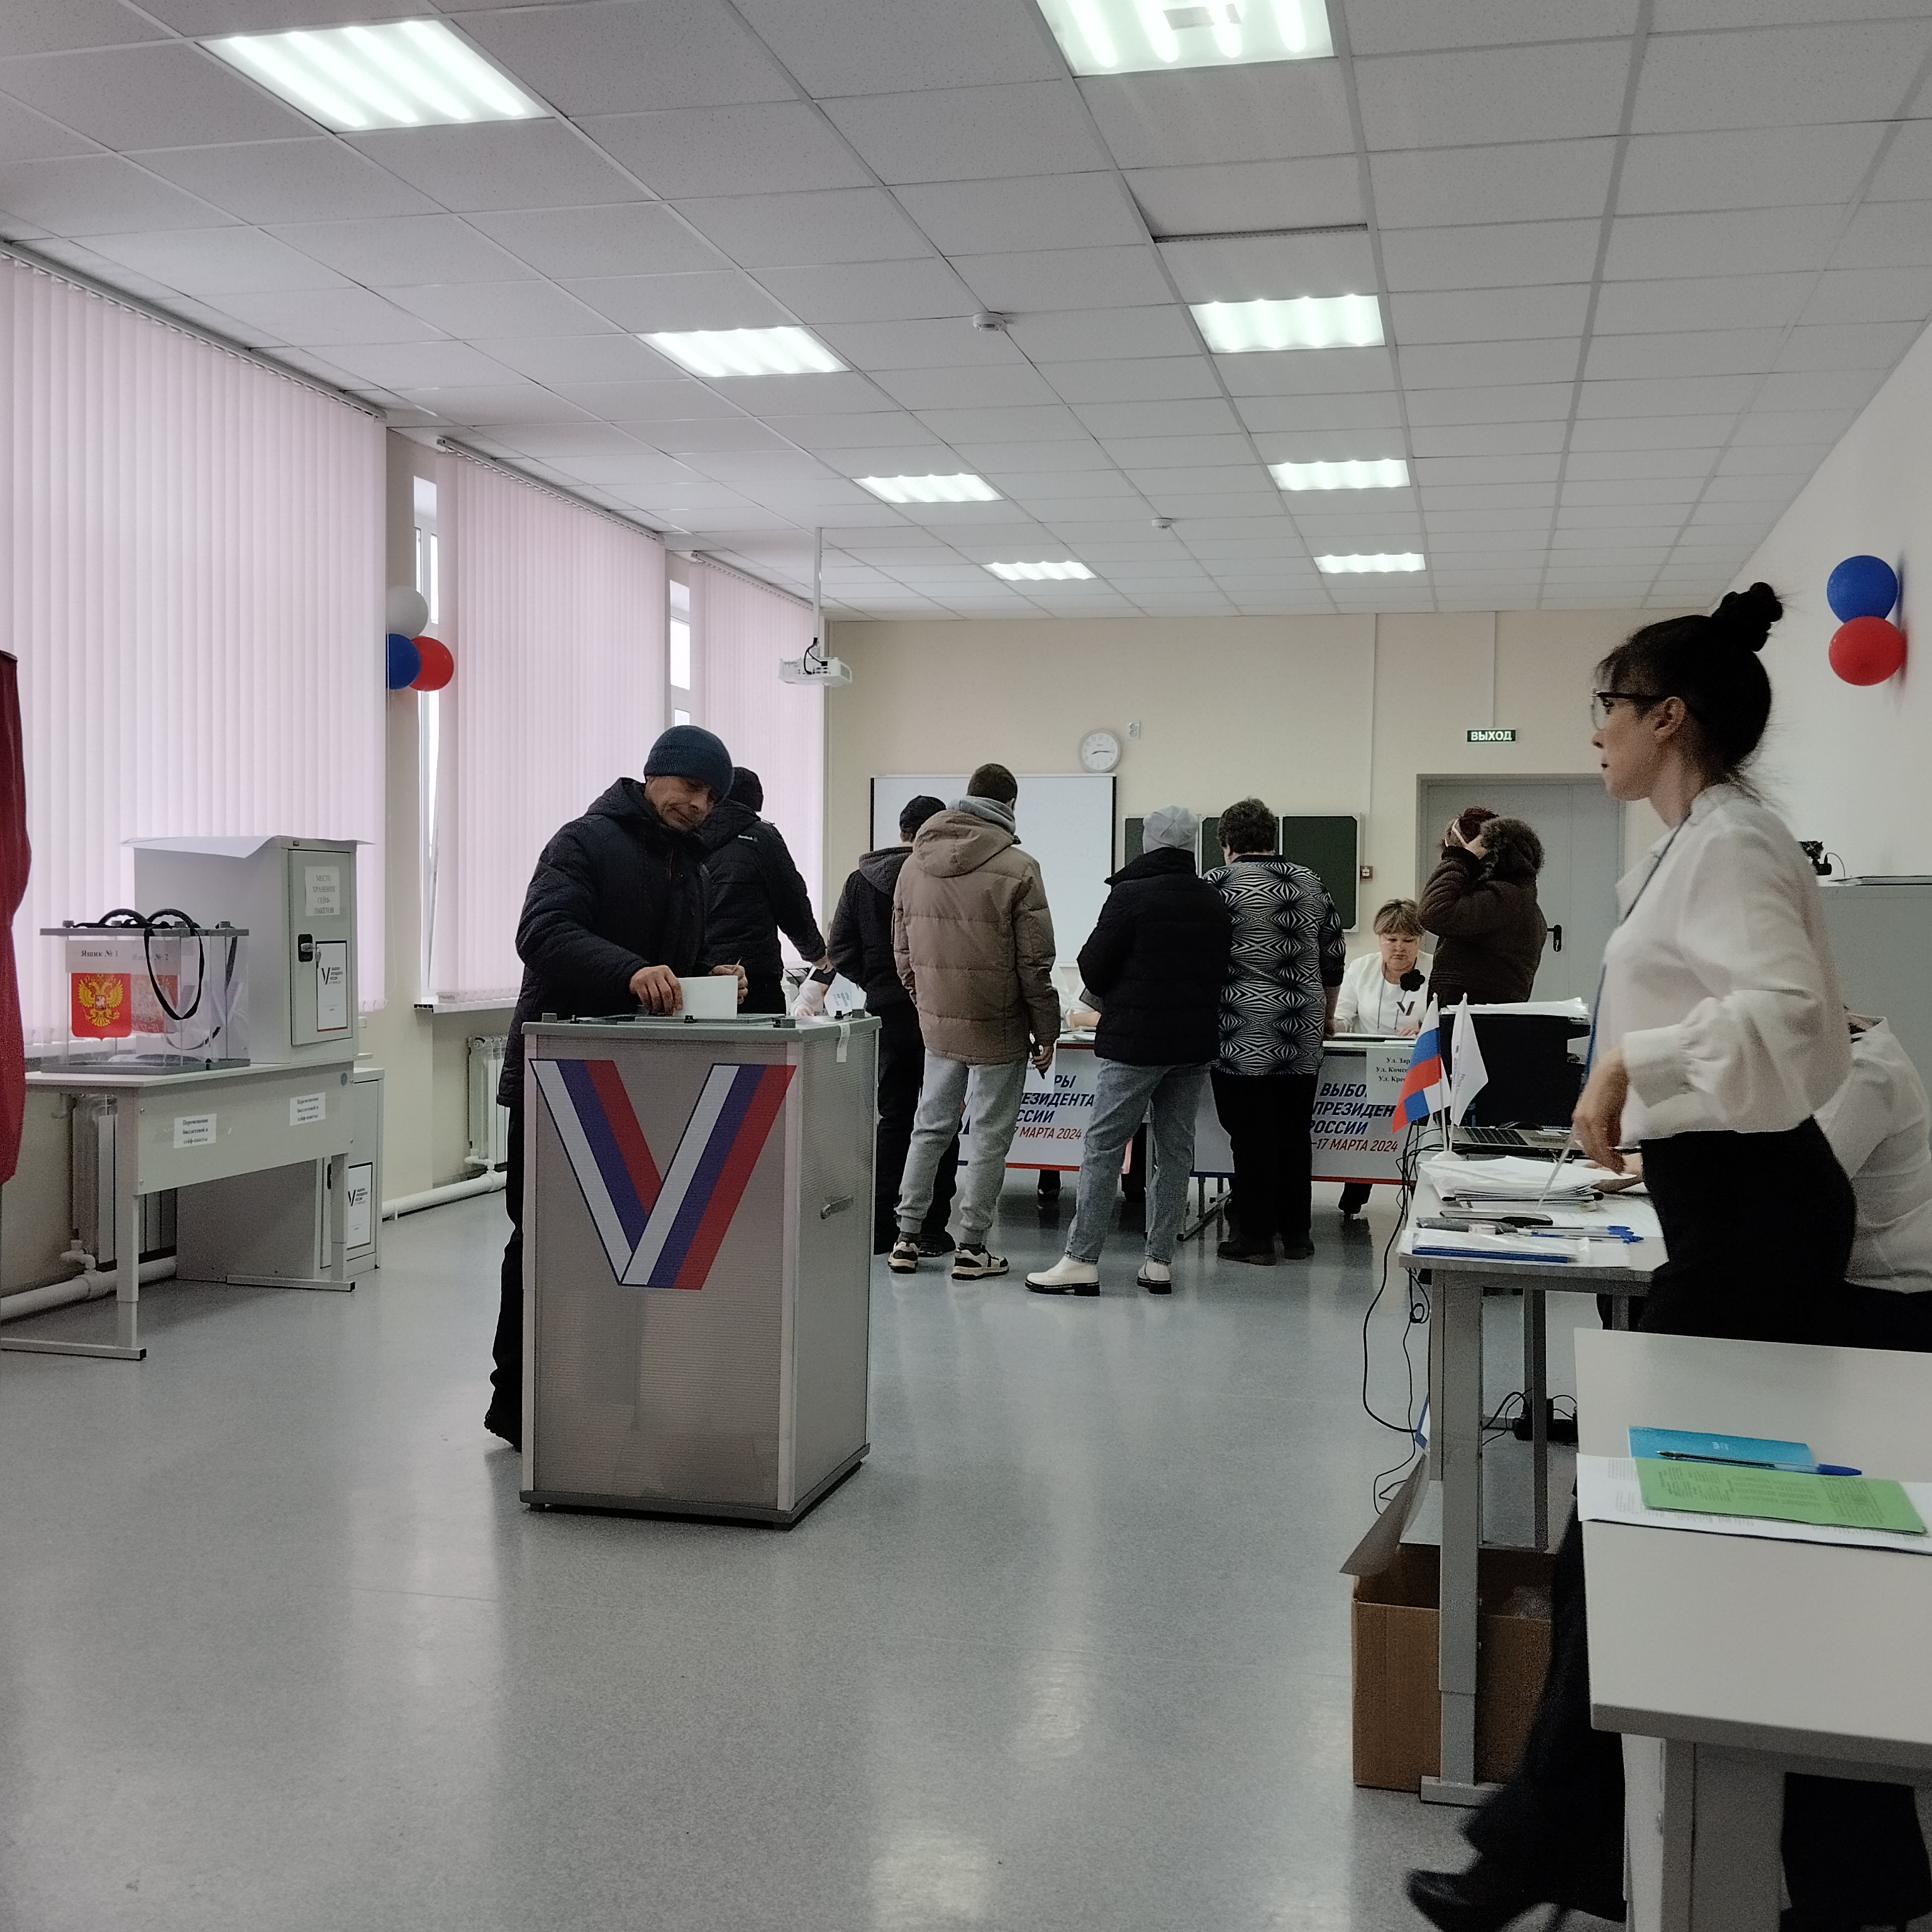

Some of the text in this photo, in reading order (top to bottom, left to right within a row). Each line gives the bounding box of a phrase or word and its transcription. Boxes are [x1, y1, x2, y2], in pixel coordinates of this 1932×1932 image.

[1471, 731, 1512, 741] ВЫХОД
[1054, 1075, 1077, 1088] РЫ
[1319, 1082, 1367, 1097] ВЫБО
[1021, 1092, 1096, 1108] ЕЗИДЕНТА
[1017, 1109, 1055, 1123] ССИИ
[1312, 1101, 1397, 1119] ПРЕЗИДЕН
[1019, 1126, 1055, 1138] МАРТА
[1057, 1128, 1082, 1140] 2024
[1330, 1138, 1368, 1151] МАРТА
[1370, 1140, 1398, 1152] 2024
